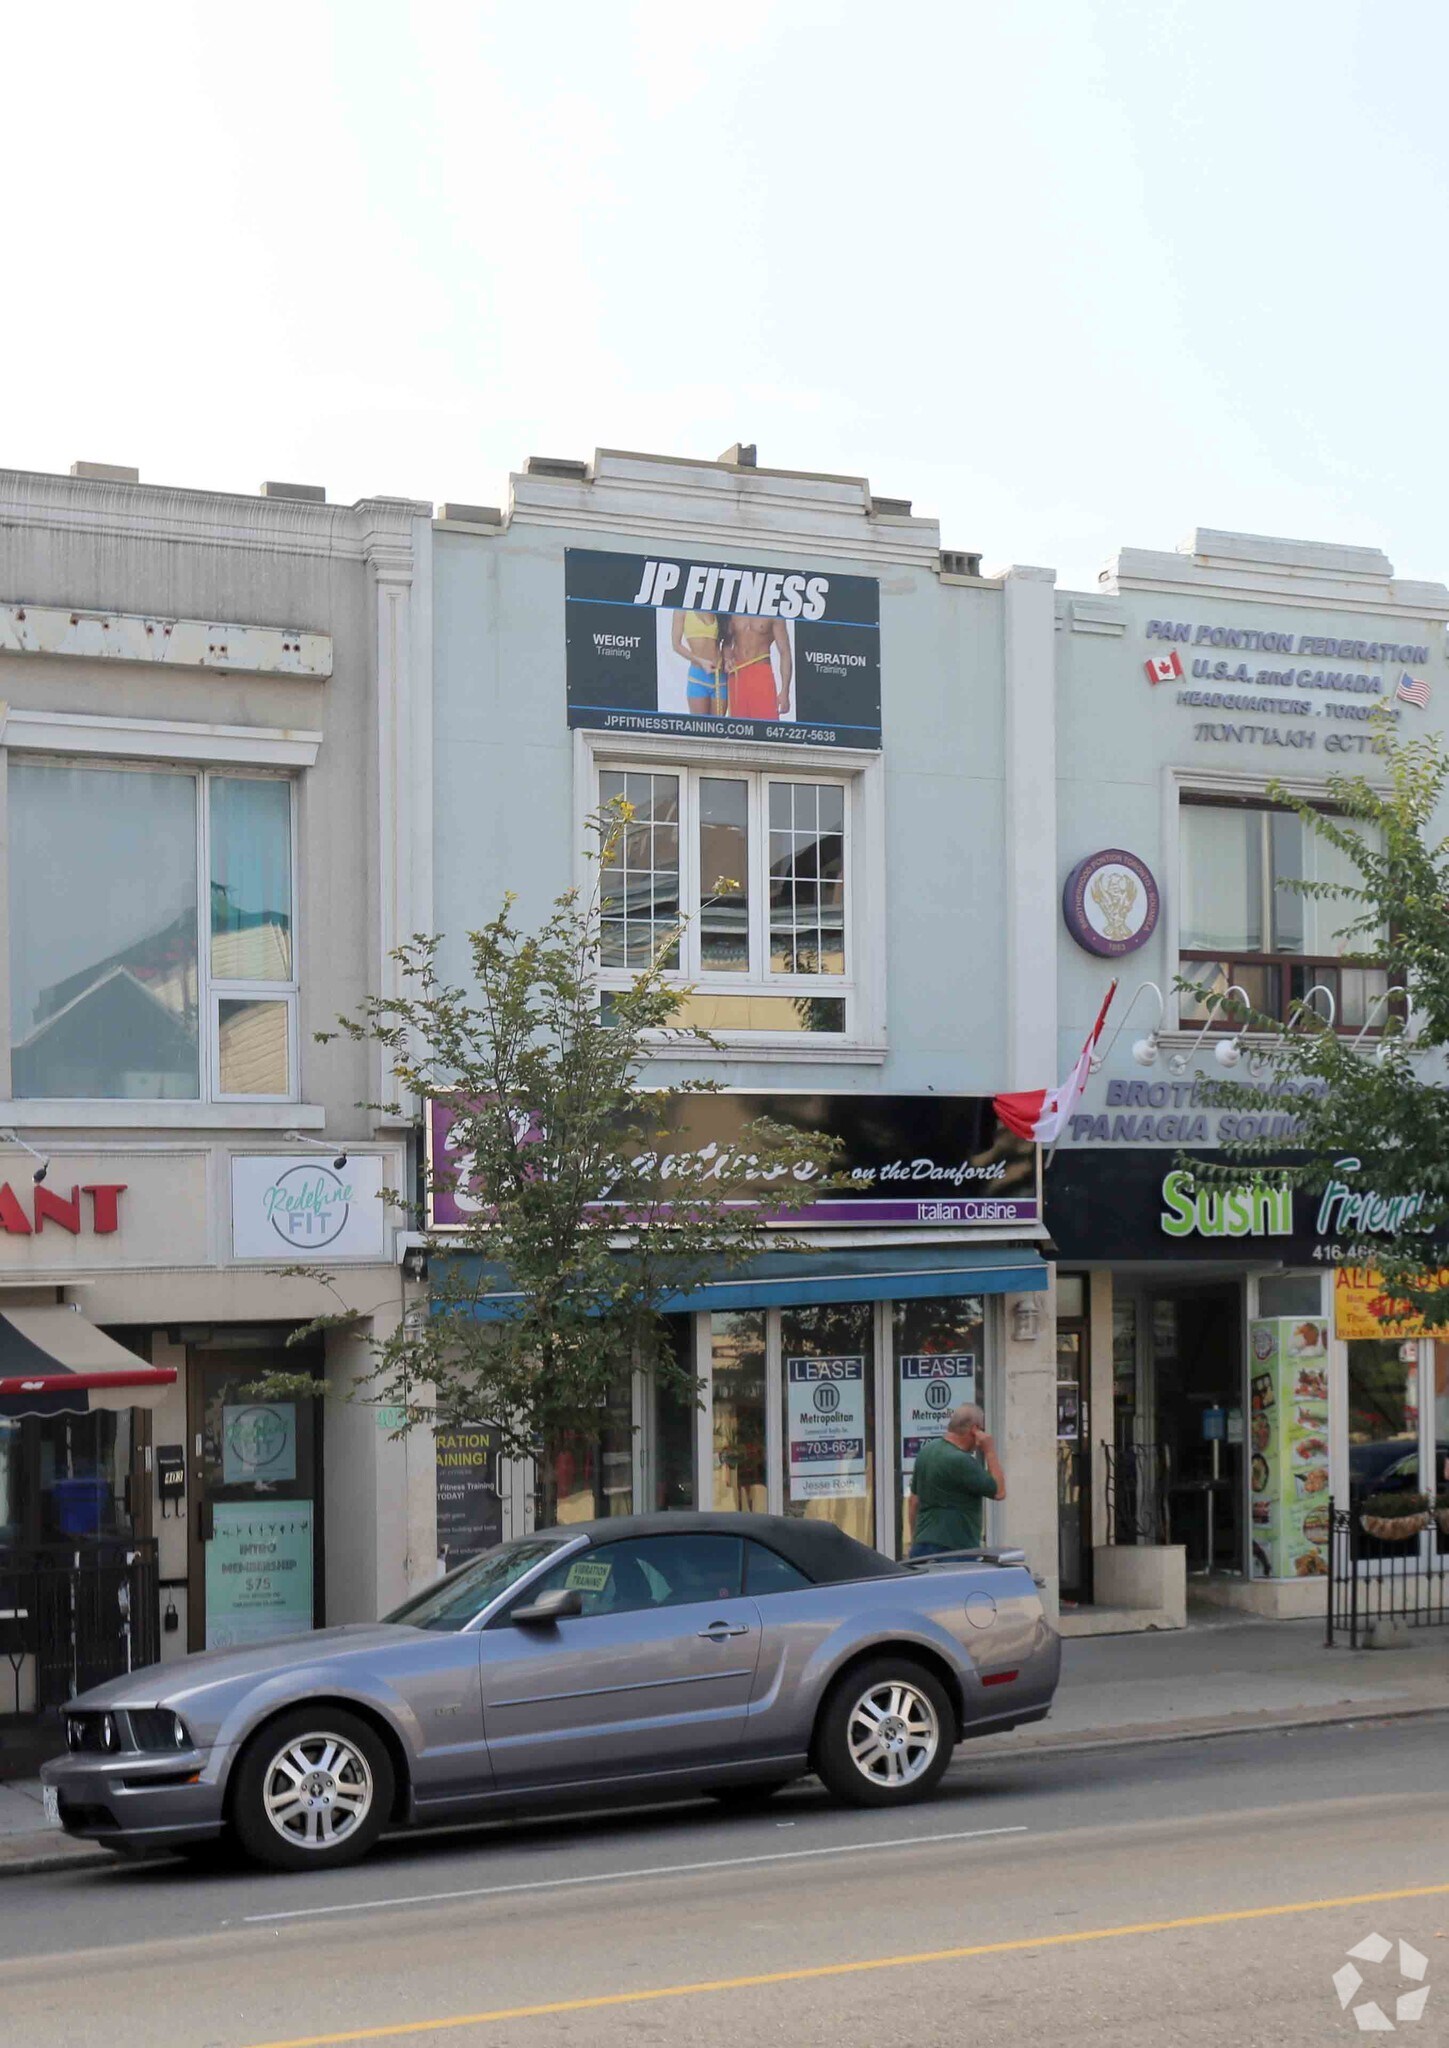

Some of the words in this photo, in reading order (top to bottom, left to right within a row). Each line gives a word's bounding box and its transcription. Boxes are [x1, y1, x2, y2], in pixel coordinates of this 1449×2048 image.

[633, 561, 681, 606] JP
[682, 565, 830, 621] FITNESS
[593, 633, 641, 648] WEIGHT
[1146, 620, 1192, 643] PAN
[1195, 625, 1295, 653] PONTION
[1299, 635, 1430, 664] FEDERATION
[596, 645, 632, 659] Training
[805, 651, 866, 667] VIBRATION
[814, 663, 847, 677] Training
[1192, 659, 1255, 684] U.S.A.
[1256, 667, 1295, 687] and
[1296, 670, 1382, 695] CANADA
[1177, 690, 1312, 716] HEADQUARTERS
[604, 714, 754, 736] JPFITNESSTRAINING.COM
[766, 727, 836, 742] 647-227-5638
[851, 1166, 877, 1181] on
[910, 1158, 1007, 1186] Danforth
[262, 1176, 354, 1221] Redefine
[917, 1203, 961, 1220] Italian
[964, 1202, 1017, 1220] Cuisine
[288, 1212, 332, 1236] FIT
[1337, 1268, 1379, 1289] ALL
[794, 1360, 857, 1380] LEASE
[907, 1358, 968, 1377] LEASE
[799, 1411, 854, 1427] Metropolitan
[912, 1408, 954, 1423] Metropolit
[807, 1440, 859, 1455] 703-6621
[440, 1483, 466, 1491] Fitness
[467, 1481, 495, 1491] Training
[801, 1479, 831, 1493] Jesse
[573, 1563, 607, 1576] VIBRATION
[571, 1575, 602, 1588] TRAINING
